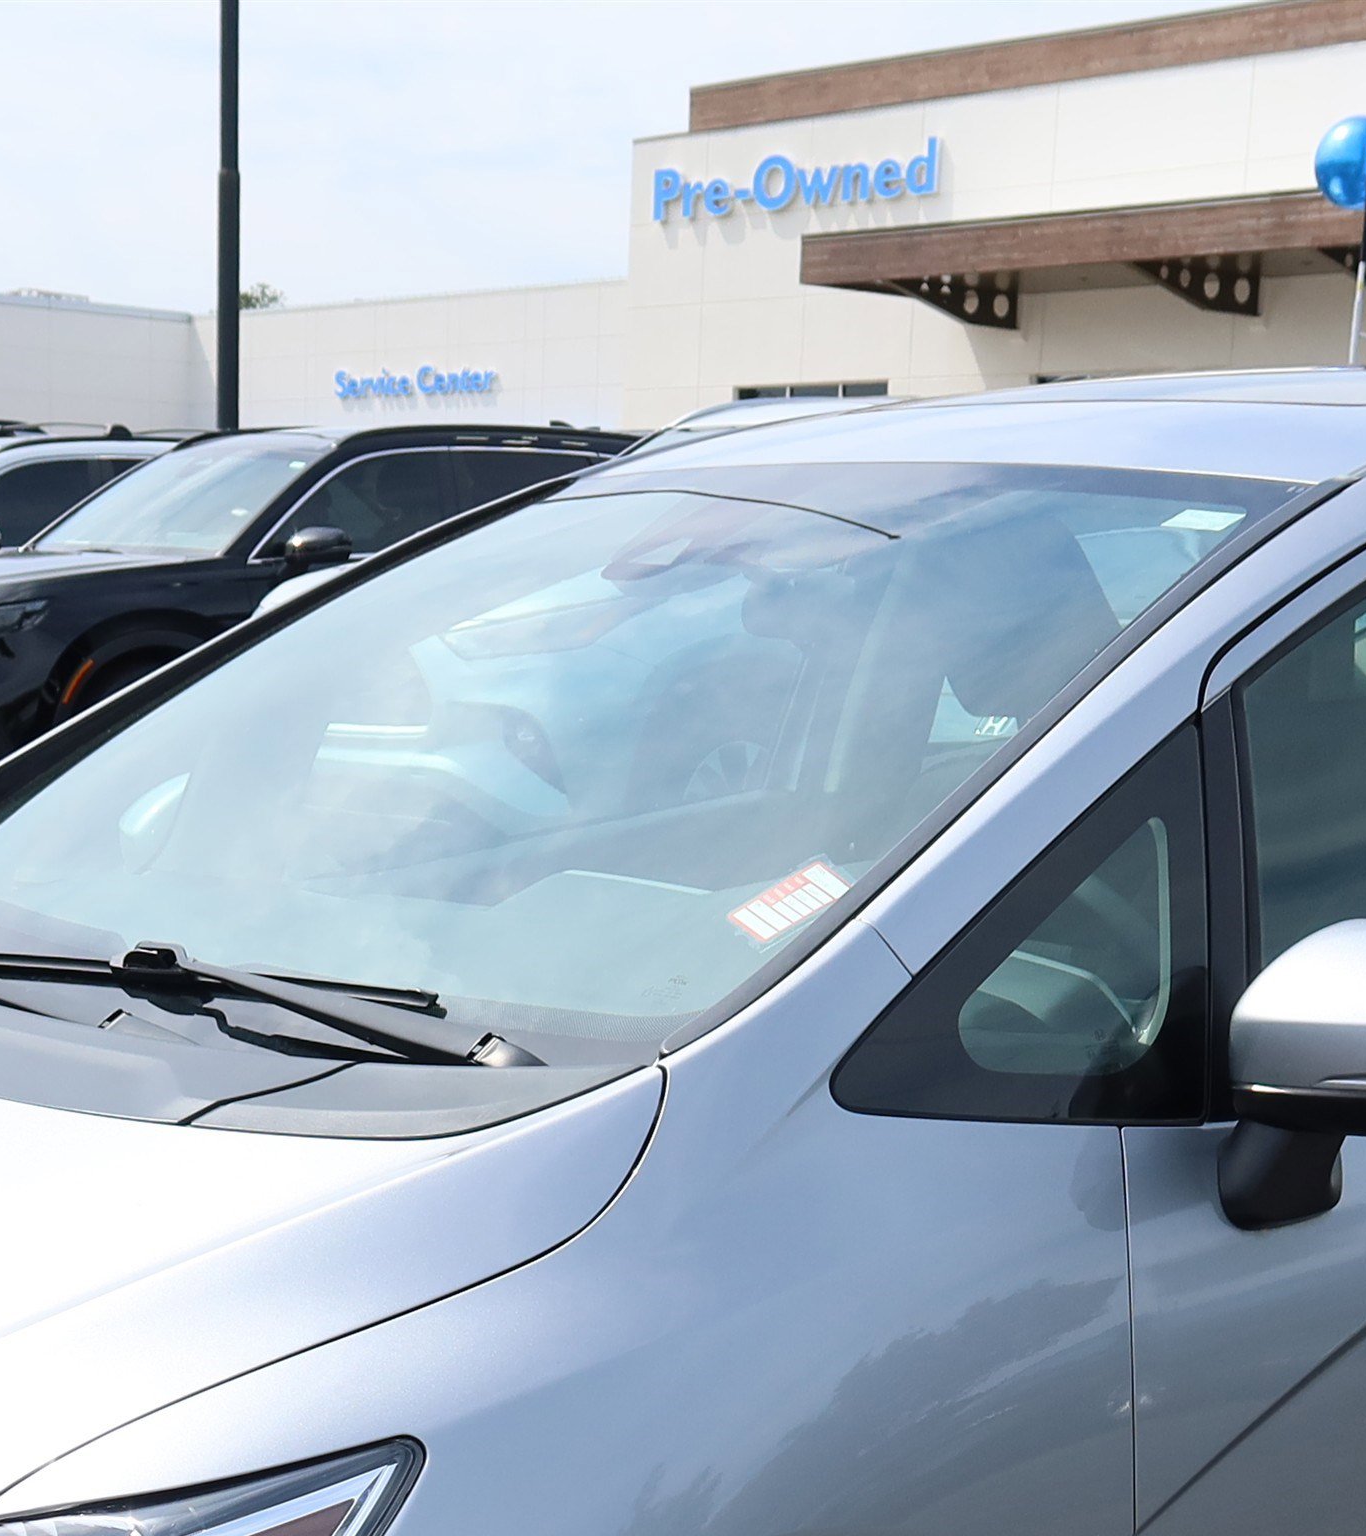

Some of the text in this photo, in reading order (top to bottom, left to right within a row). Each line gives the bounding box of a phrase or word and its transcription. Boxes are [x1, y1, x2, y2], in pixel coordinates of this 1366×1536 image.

[653, 136, 938, 222] Pre-Owned
[333, 364, 496, 399] Service Center
